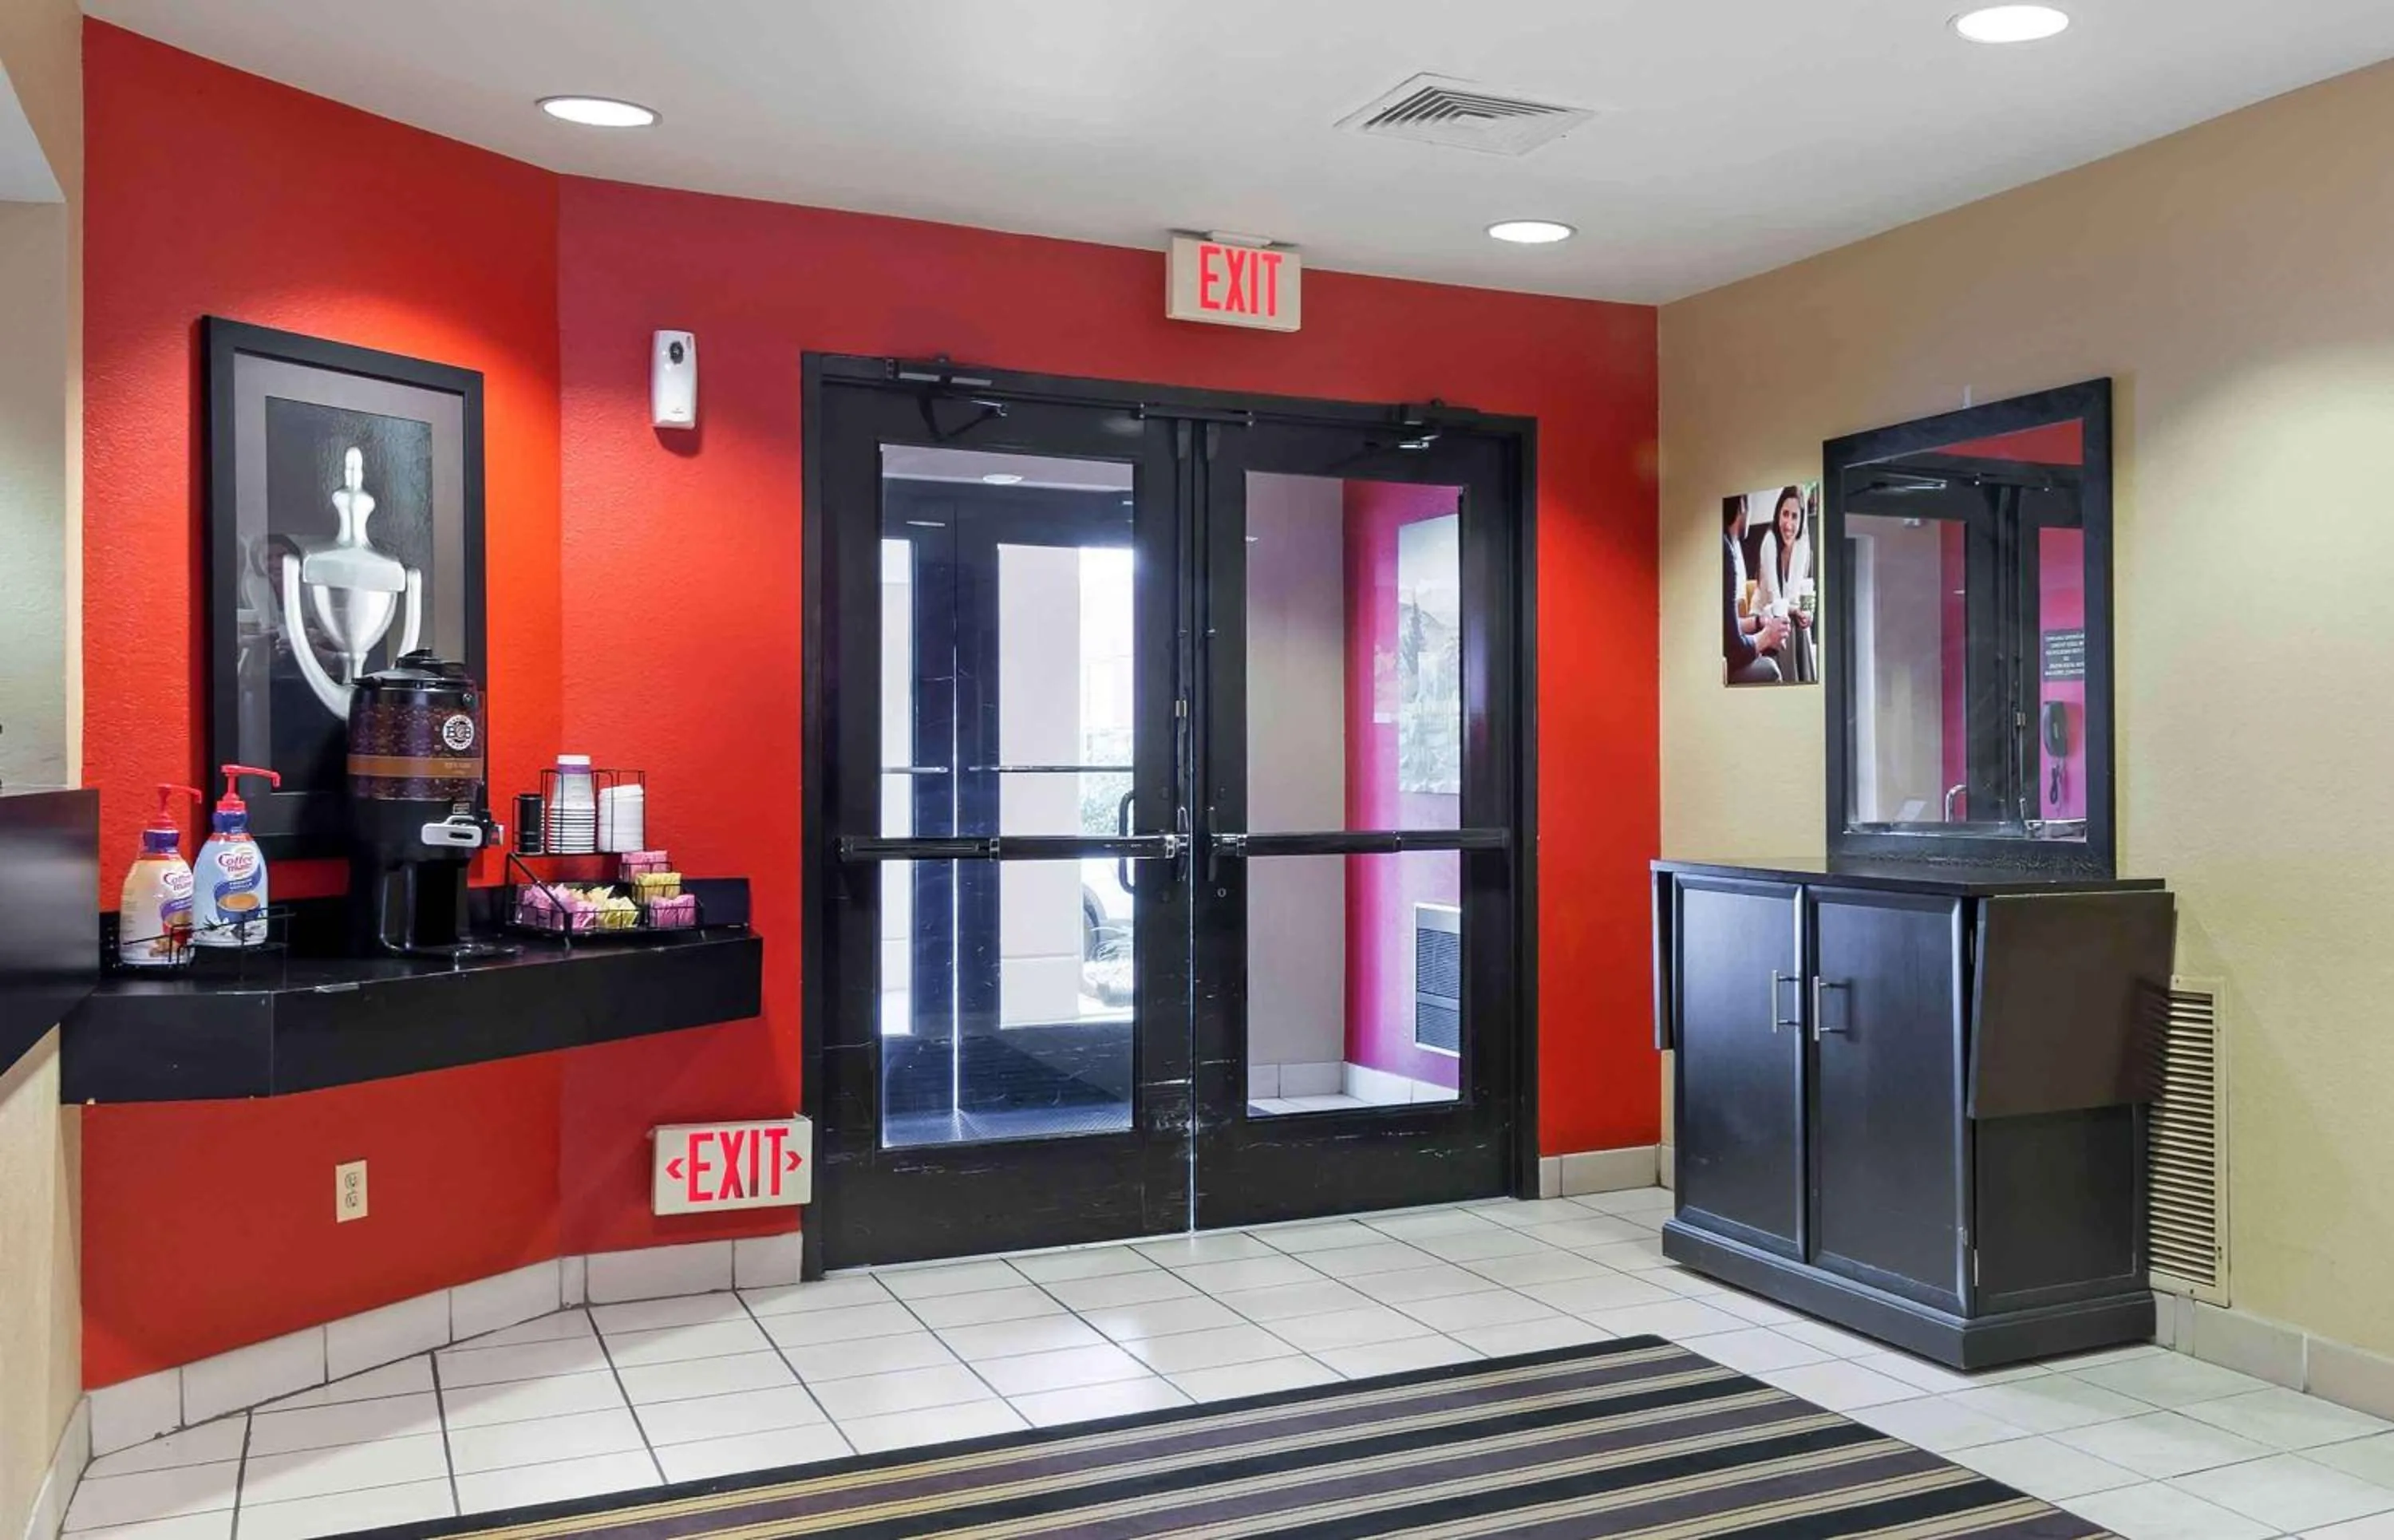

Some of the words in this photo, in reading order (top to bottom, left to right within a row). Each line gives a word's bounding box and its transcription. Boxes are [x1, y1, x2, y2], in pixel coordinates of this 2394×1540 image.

[1199, 245, 1282, 316] EXIT
[218, 853, 255, 867] Coffee
[688, 1127, 788, 1202] EXIT
